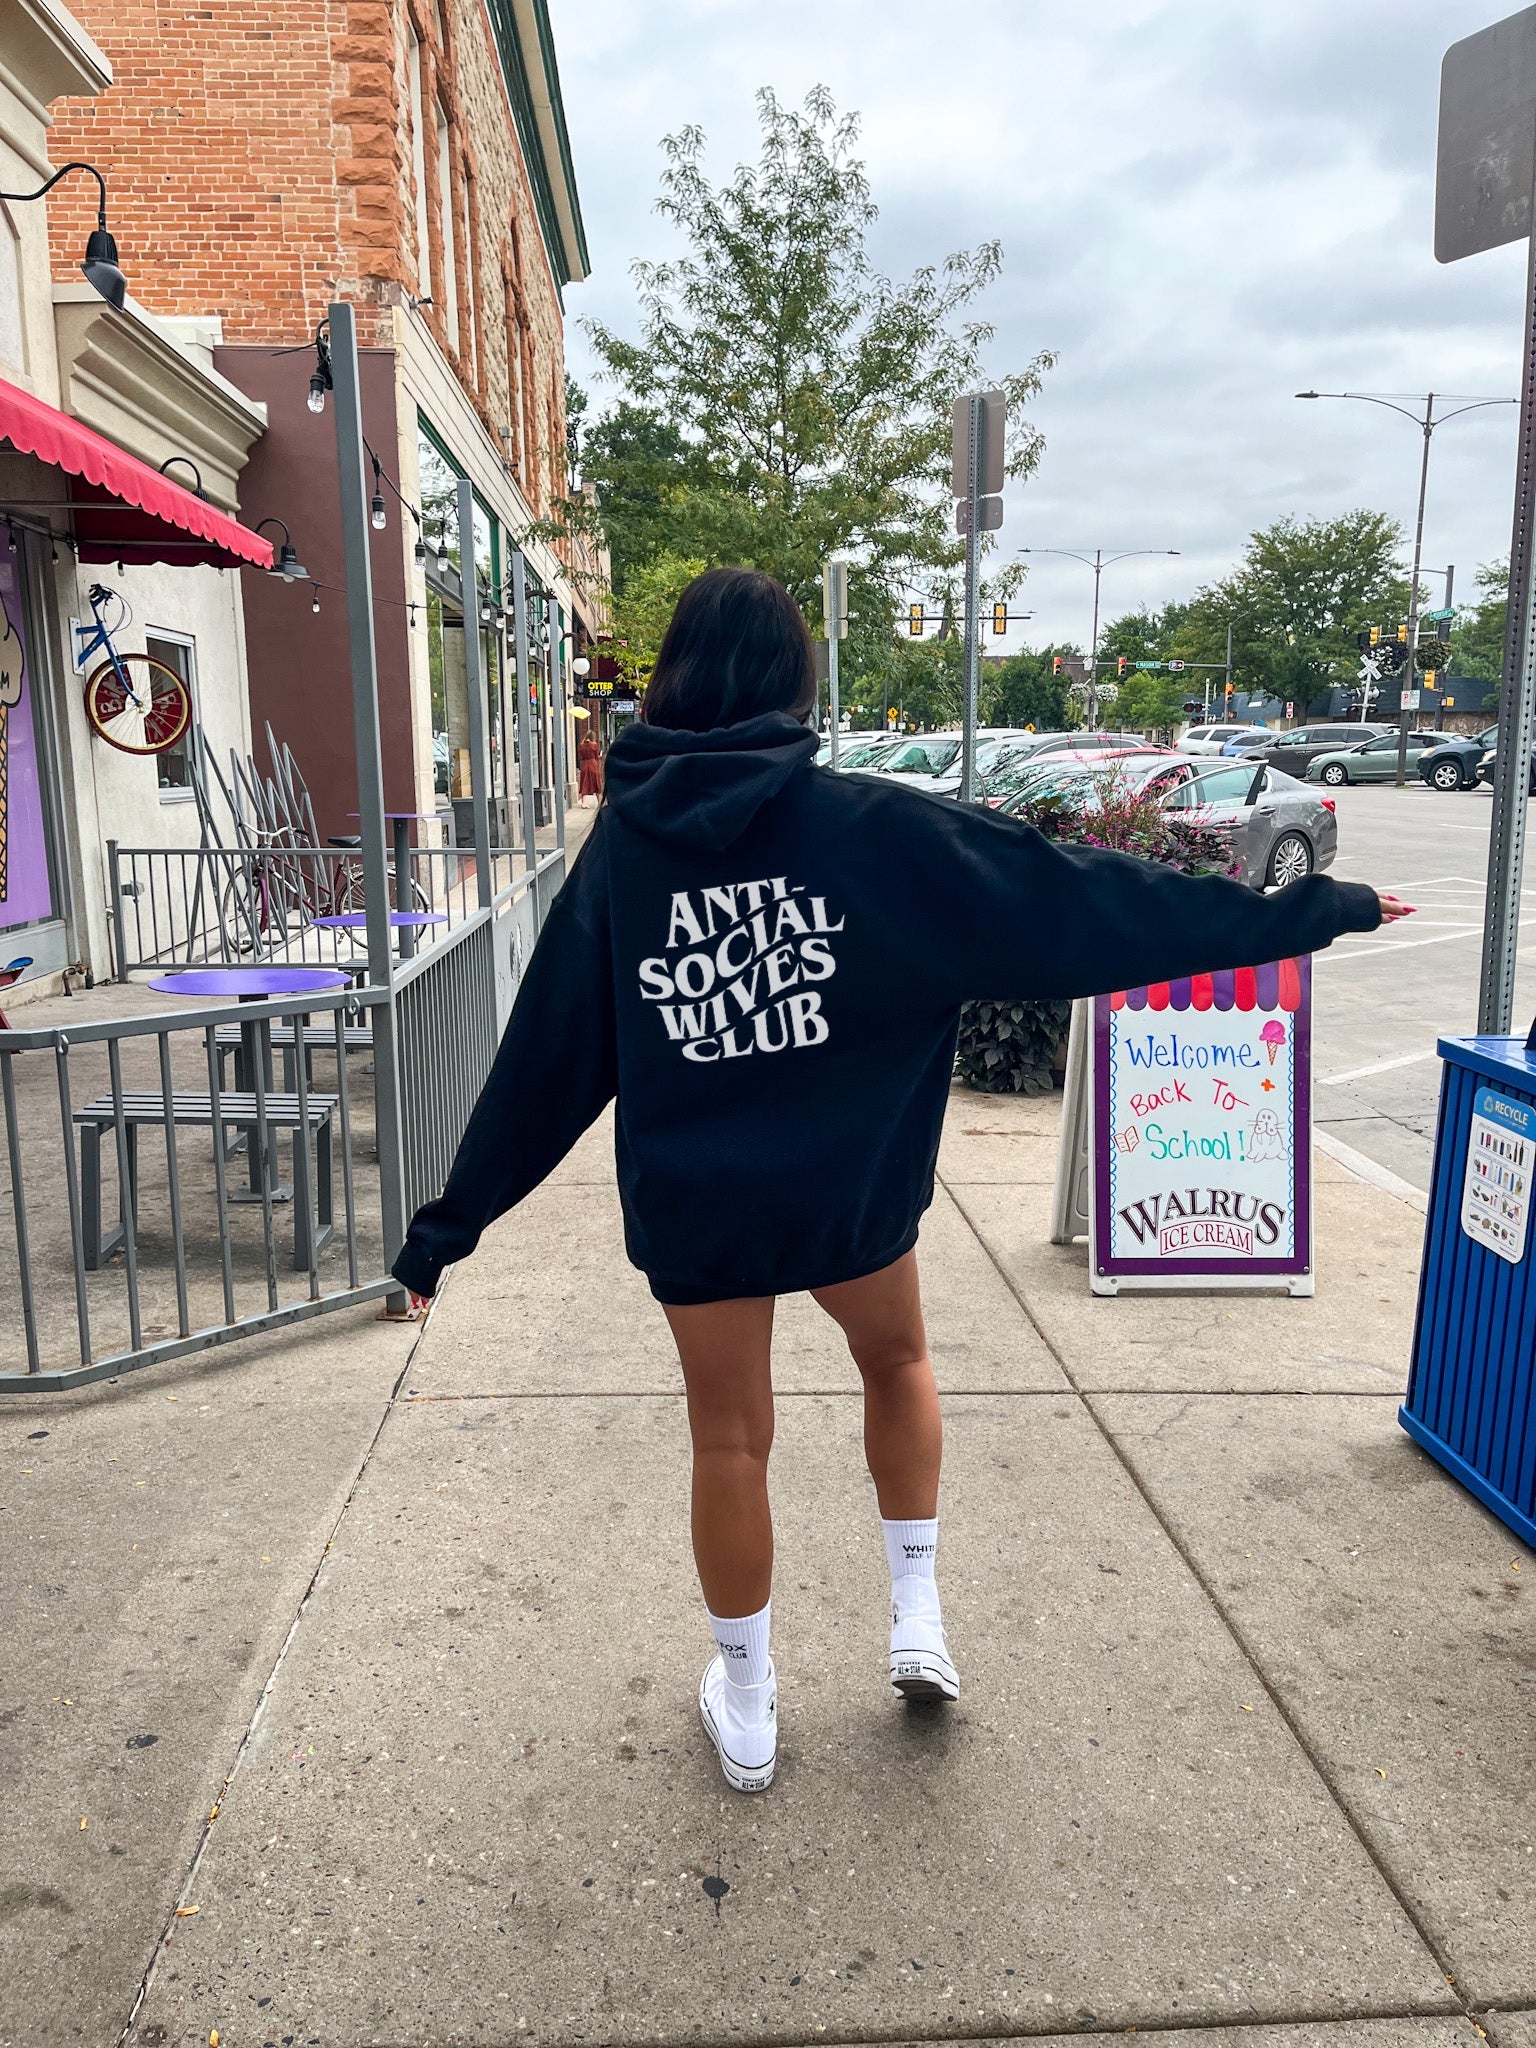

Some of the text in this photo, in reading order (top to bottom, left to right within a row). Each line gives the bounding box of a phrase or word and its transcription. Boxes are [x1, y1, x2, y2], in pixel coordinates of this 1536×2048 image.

[587, 682, 613, 690] OTTER
[665, 876, 806, 948] ANTI-
[638, 896, 846, 1000] SOCIAL
[656, 938, 837, 1040] WIVES
[681, 991, 830, 1062] CLUB
[1125, 1034, 1261, 1069] Welcome
[1130, 1078, 1249, 1117] Back To
[1494, 1100, 1529, 1126] RECYCLE
[1117, 1187, 1286, 1246] WALRUS
[1163, 1223, 1250, 1252] ICE CREAM
